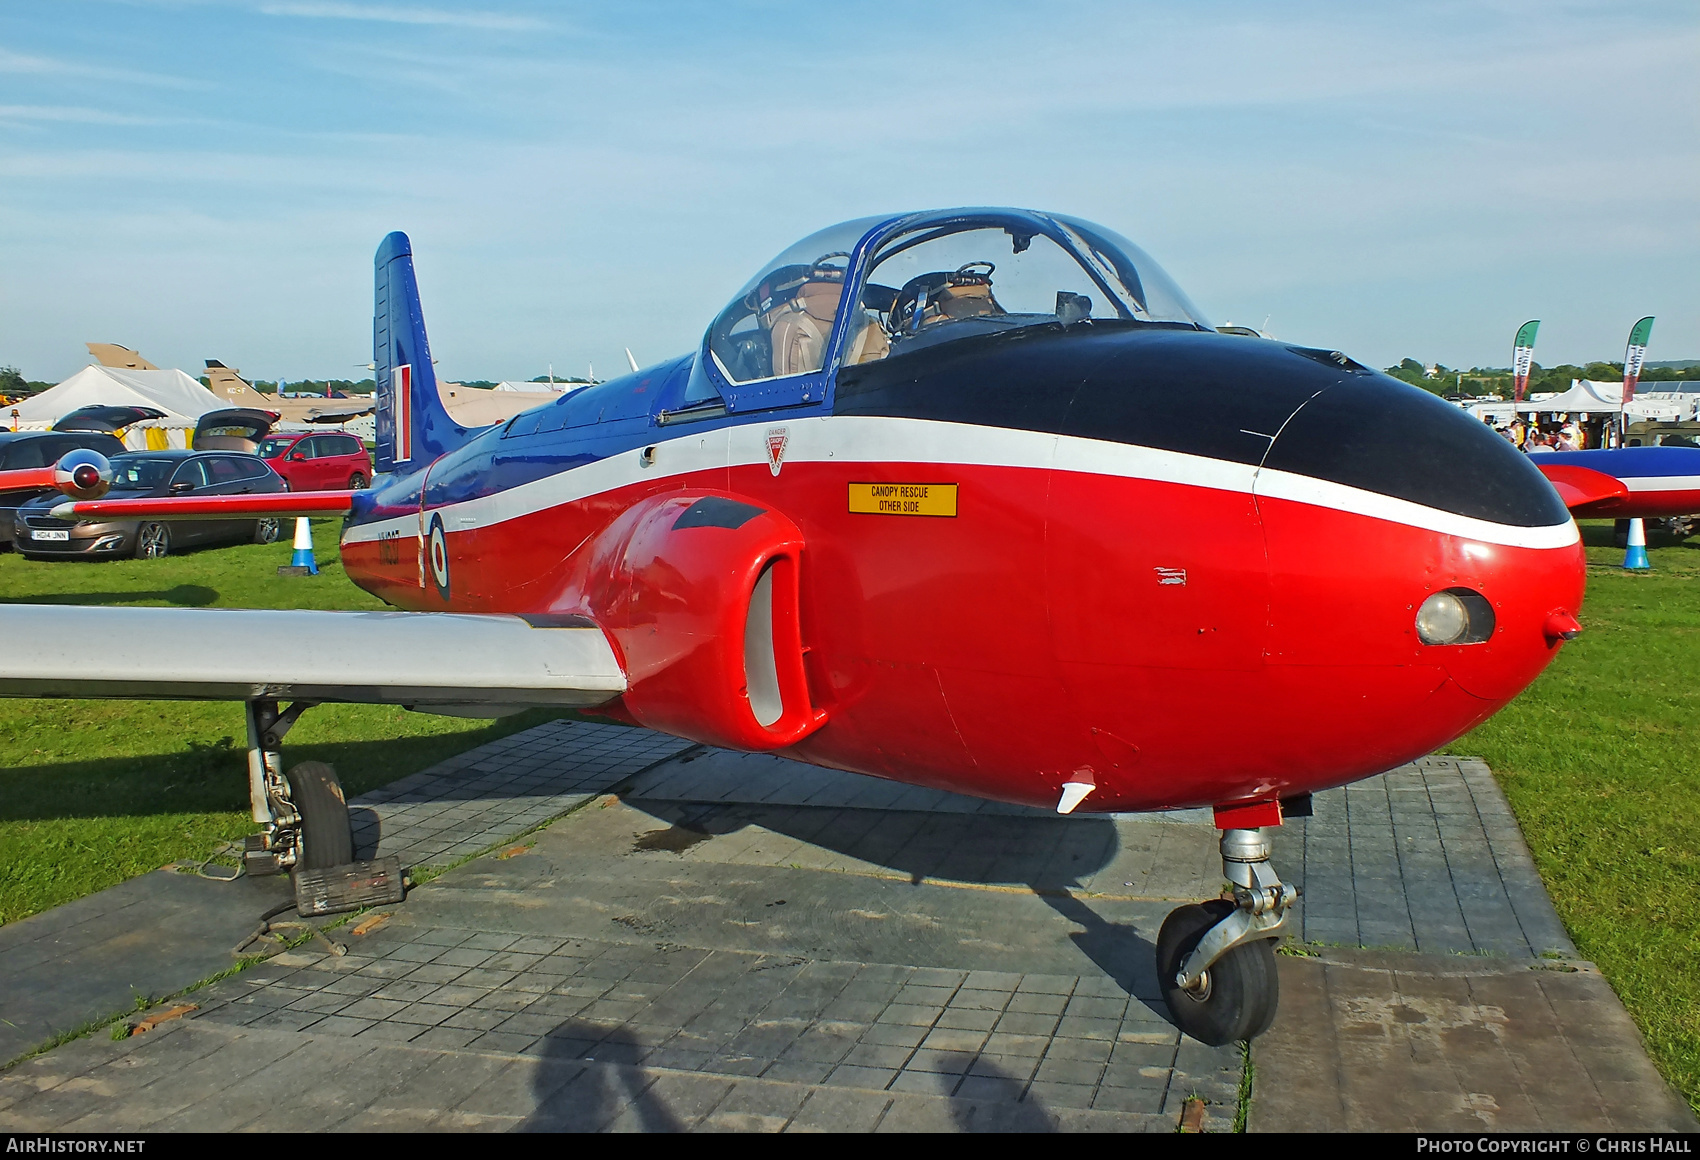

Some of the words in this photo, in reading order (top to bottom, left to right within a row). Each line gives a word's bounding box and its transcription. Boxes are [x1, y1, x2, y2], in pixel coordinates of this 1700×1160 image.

[1517, 329, 1528, 352] Italy
[1630, 327, 1642, 350] Italy
[872, 486, 898, 497] CANOPY
[900, 486, 928, 498] RESCUE
[879, 500, 901, 511] OTHER
[903, 501, 919, 512] SIDE
